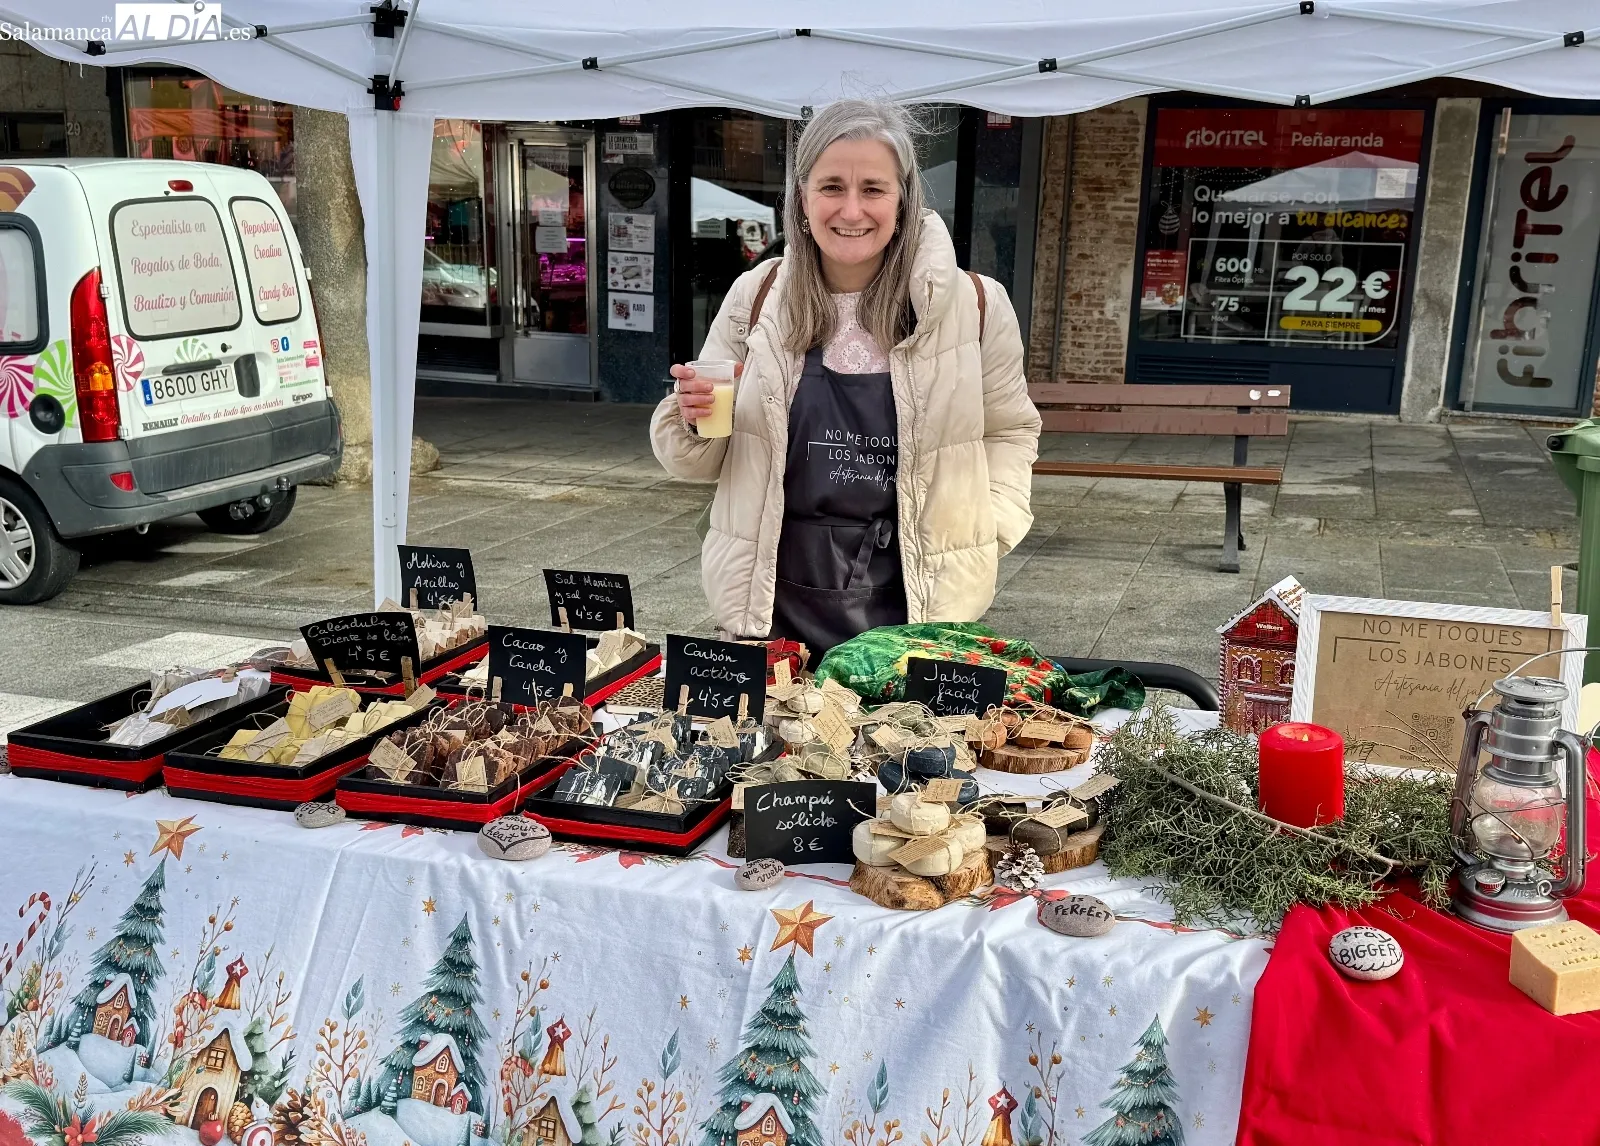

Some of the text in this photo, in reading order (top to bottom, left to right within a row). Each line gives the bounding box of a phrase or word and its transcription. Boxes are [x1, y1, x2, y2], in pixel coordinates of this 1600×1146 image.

[1291, 132, 1384, 148] Peñaranda
[1192, 207, 1209, 223] lo
[1214, 208, 1274, 228] mejor
[1278, 213, 1290, 226] a
[1296, 208, 1318, 227] tu
[131, 219, 206, 239] Especialista en
[254, 245, 282, 261] Creativa
[1310, 253, 1332, 262] SOLO
[131, 252, 223, 276] Regalos de Boda,
[1215, 257, 1251, 273] 600
[134, 287, 235, 312] Bautizo y Comunión
[258, 285, 295, 302] Candy Bar
[1371, 306, 1386, 314] mes
[1301, 319, 1361, 330] PARA SIEMPRE
[153, 377, 197, 399] 8600
[201, 368, 230, 392] GHY
[142, 417, 178, 431] RENAULT
[181, 413, 211, 425] Detalles
[825, 429, 842, 441] NO
[846, 431, 862, 446] ME
[829, 448, 851, 461] LOS
[456, 562, 465, 578] y
[555, 573, 577, 585] Sal
[566, 589, 581, 599] sal
[588, 593, 615, 603] rosa
[1362, 618, 1523, 647] NO ME TOQUES
[502, 632, 568, 664] Cacao y
[683, 642, 738, 662] Carbón
[509, 654, 556, 675] Canela
[1368, 646, 1512, 674] LOS JABONES
[690, 666, 751, 684] activo
[923, 663, 982, 687] Jabón
[936, 682, 980, 704] facial
[1447, 677, 1466, 702] del
[756, 790, 835, 812] Champú
[486, 826, 519, 843] heart
[1339, 943, 1399, 966] BIGGER
